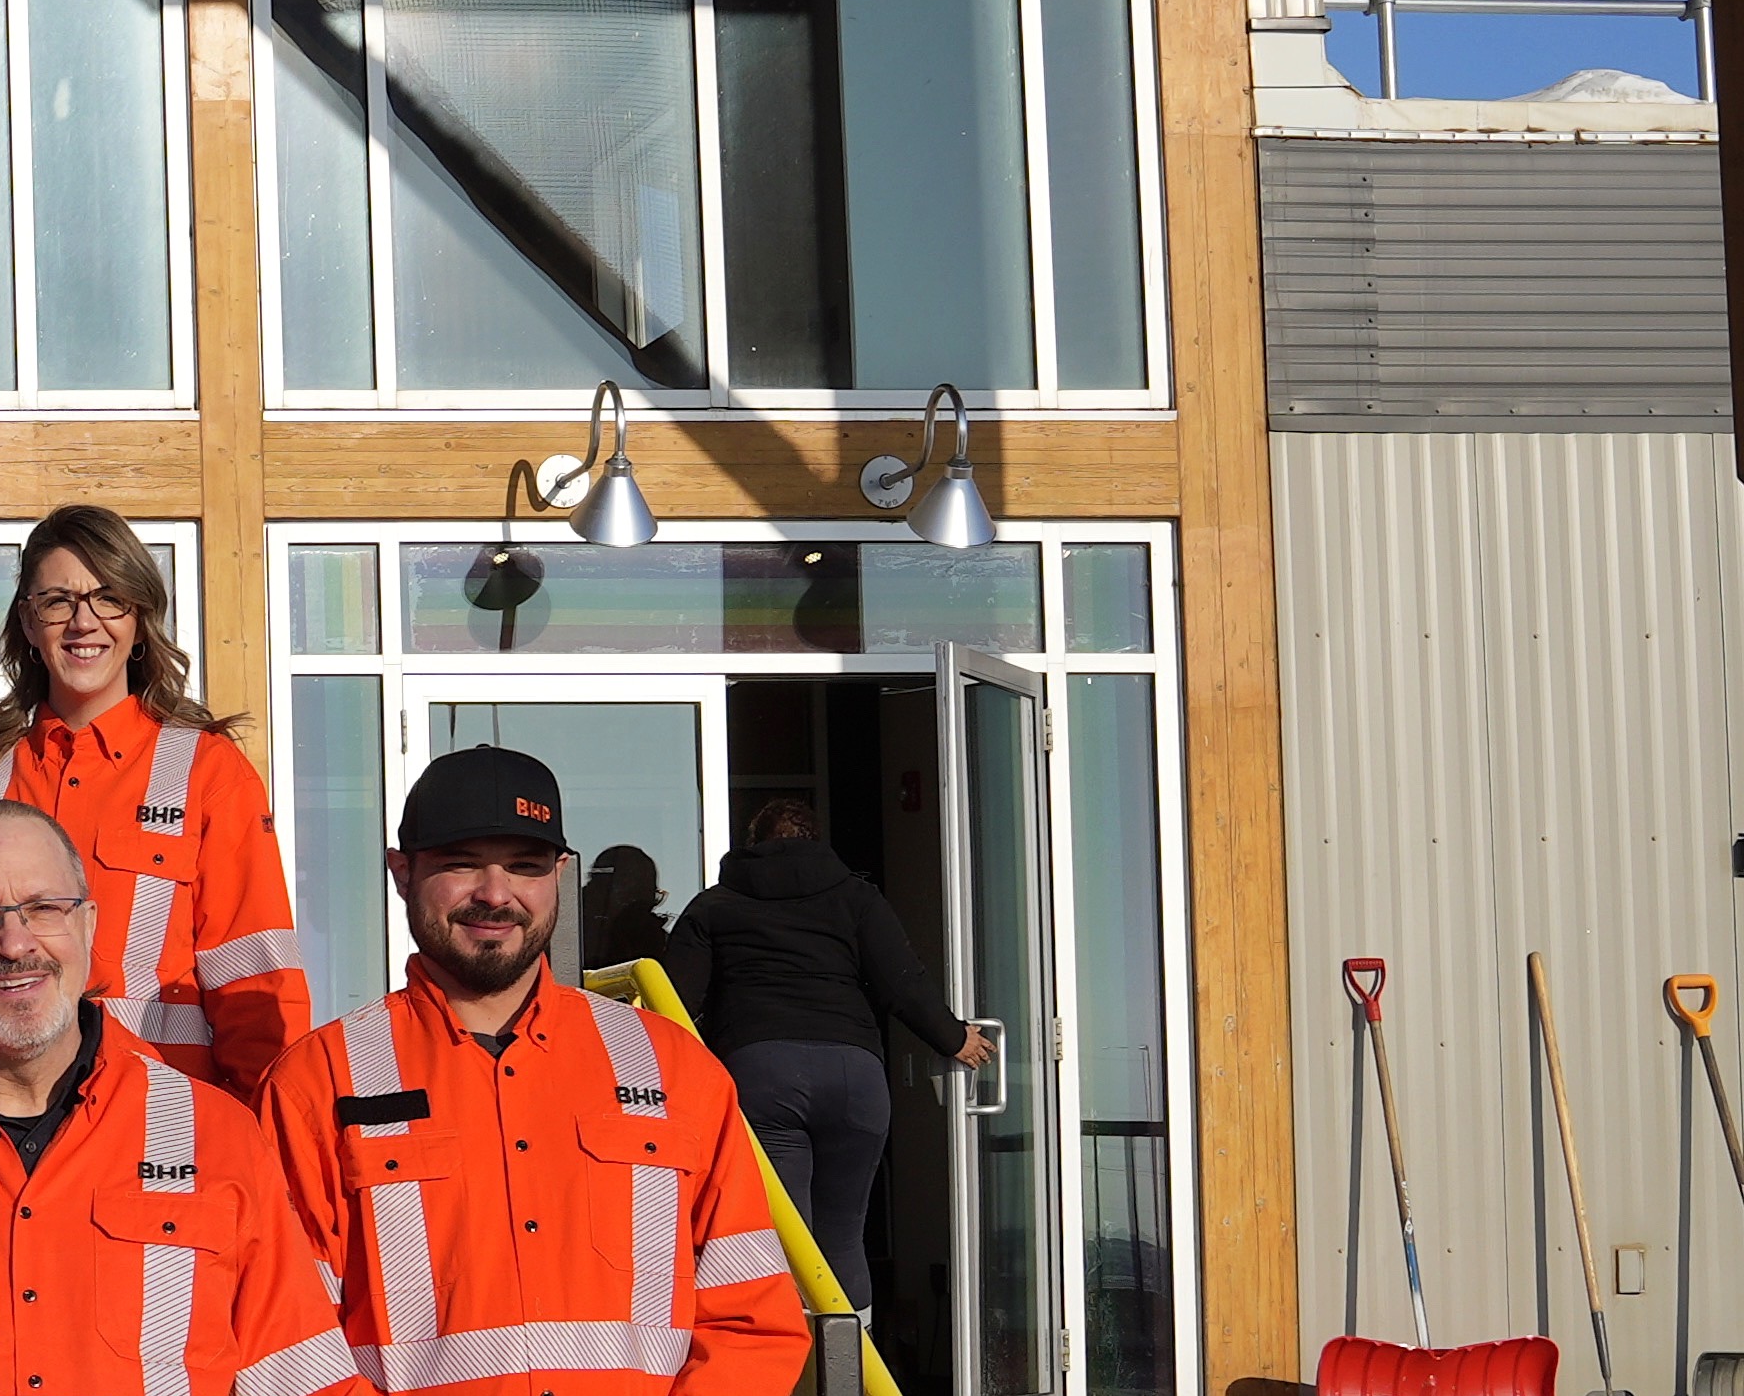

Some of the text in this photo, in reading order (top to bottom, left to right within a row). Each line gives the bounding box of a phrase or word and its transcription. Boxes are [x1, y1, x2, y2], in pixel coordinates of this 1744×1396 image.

[136, 804, 186, 825] BHP
[516, 797, 551, 824] BHP
[614, 1086, 668, 1106] BHP
[137, 1161, 199, 1180] BHP
